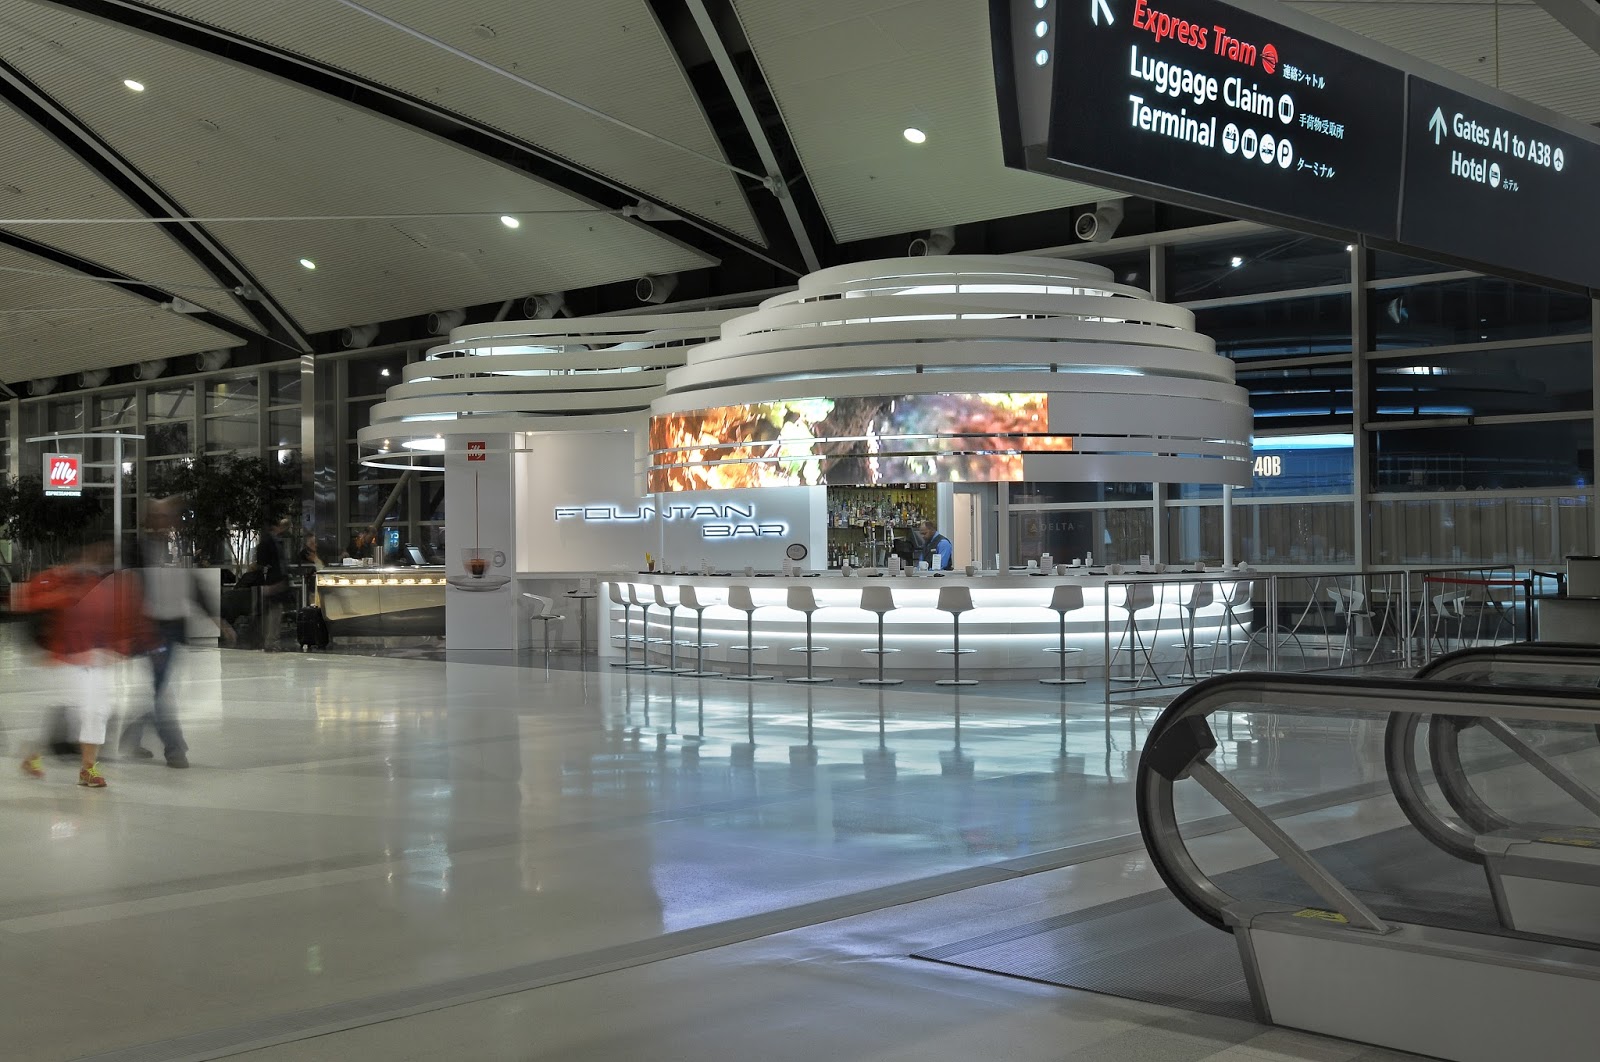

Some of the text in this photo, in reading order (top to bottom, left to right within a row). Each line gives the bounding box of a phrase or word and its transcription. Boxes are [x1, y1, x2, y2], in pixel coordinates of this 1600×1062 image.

[1132, 0, 1256, 67] Express Tram
[1130, 45, 1274, 118] Luggage Claim
[1283, 64, 1326, 90] 連絡シャトル
[1129, 95, 1217, 148] Terminal
[1298, 113, 1345, 140] 手荷物受取所
[1453, 112, 1551, 168] Gates A1 to A38
[1297, 157, 1335, 179] ターミナル
[1451, 150, 1487, 184] Hotel
[1502, 178, 1520, 192] ホテル
[50, 461, 77, 485] illy
[1251, 456, 1281, 477] 40B
[554, 505, 753, 521] FOUNTAIN
[702, 524, 786, 538] BAR
[1040, 522, 1075, 531] DELTA
